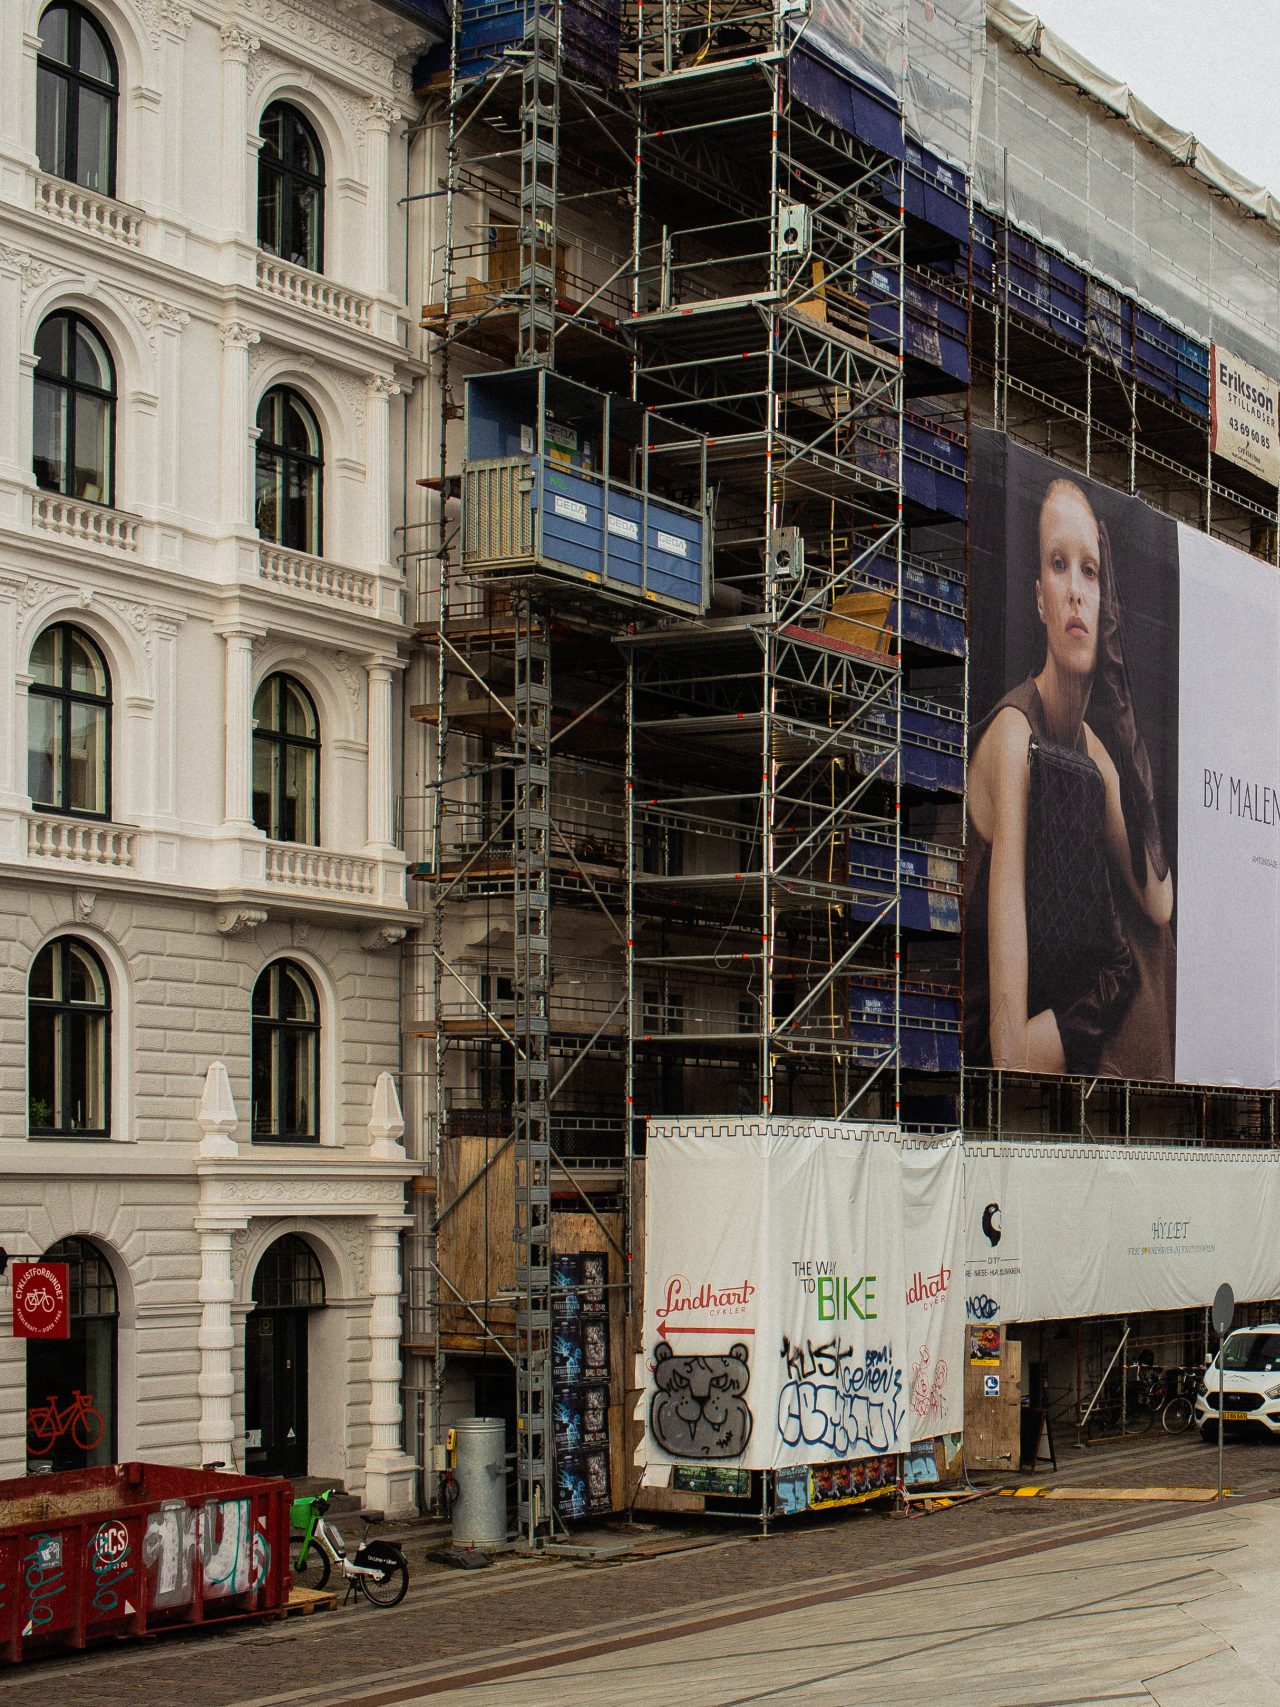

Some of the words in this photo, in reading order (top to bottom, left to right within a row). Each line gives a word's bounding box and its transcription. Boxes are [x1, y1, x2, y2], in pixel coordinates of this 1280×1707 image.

[1219, 362, 1274, 414] Eriksson
[1228, 391, 1276, 429] STILLADSER
[1228, 416, 1240, 432] 43
[1240, 421, 1251, 437] 69
[1260, 434, 1271, 450] 85
[1203, 768, 1223, 811] BY
[1151, 1216, 1192, 1240] HYLET
[15, 1267, 64, 1301] CYKLISTFORBUNDET
[792, 1261, 812, 1277] THE
[816, 1260, 837, 1275] WAY
[656, 1279, 756, 1318] Lindhart
[709, 1306, 747, 1317] CYKLER
[801, 1278, 816, 1294] TO
[818, 1276, 878, 1321] BIKE
[99, 1528, 126, 1555] HCS
